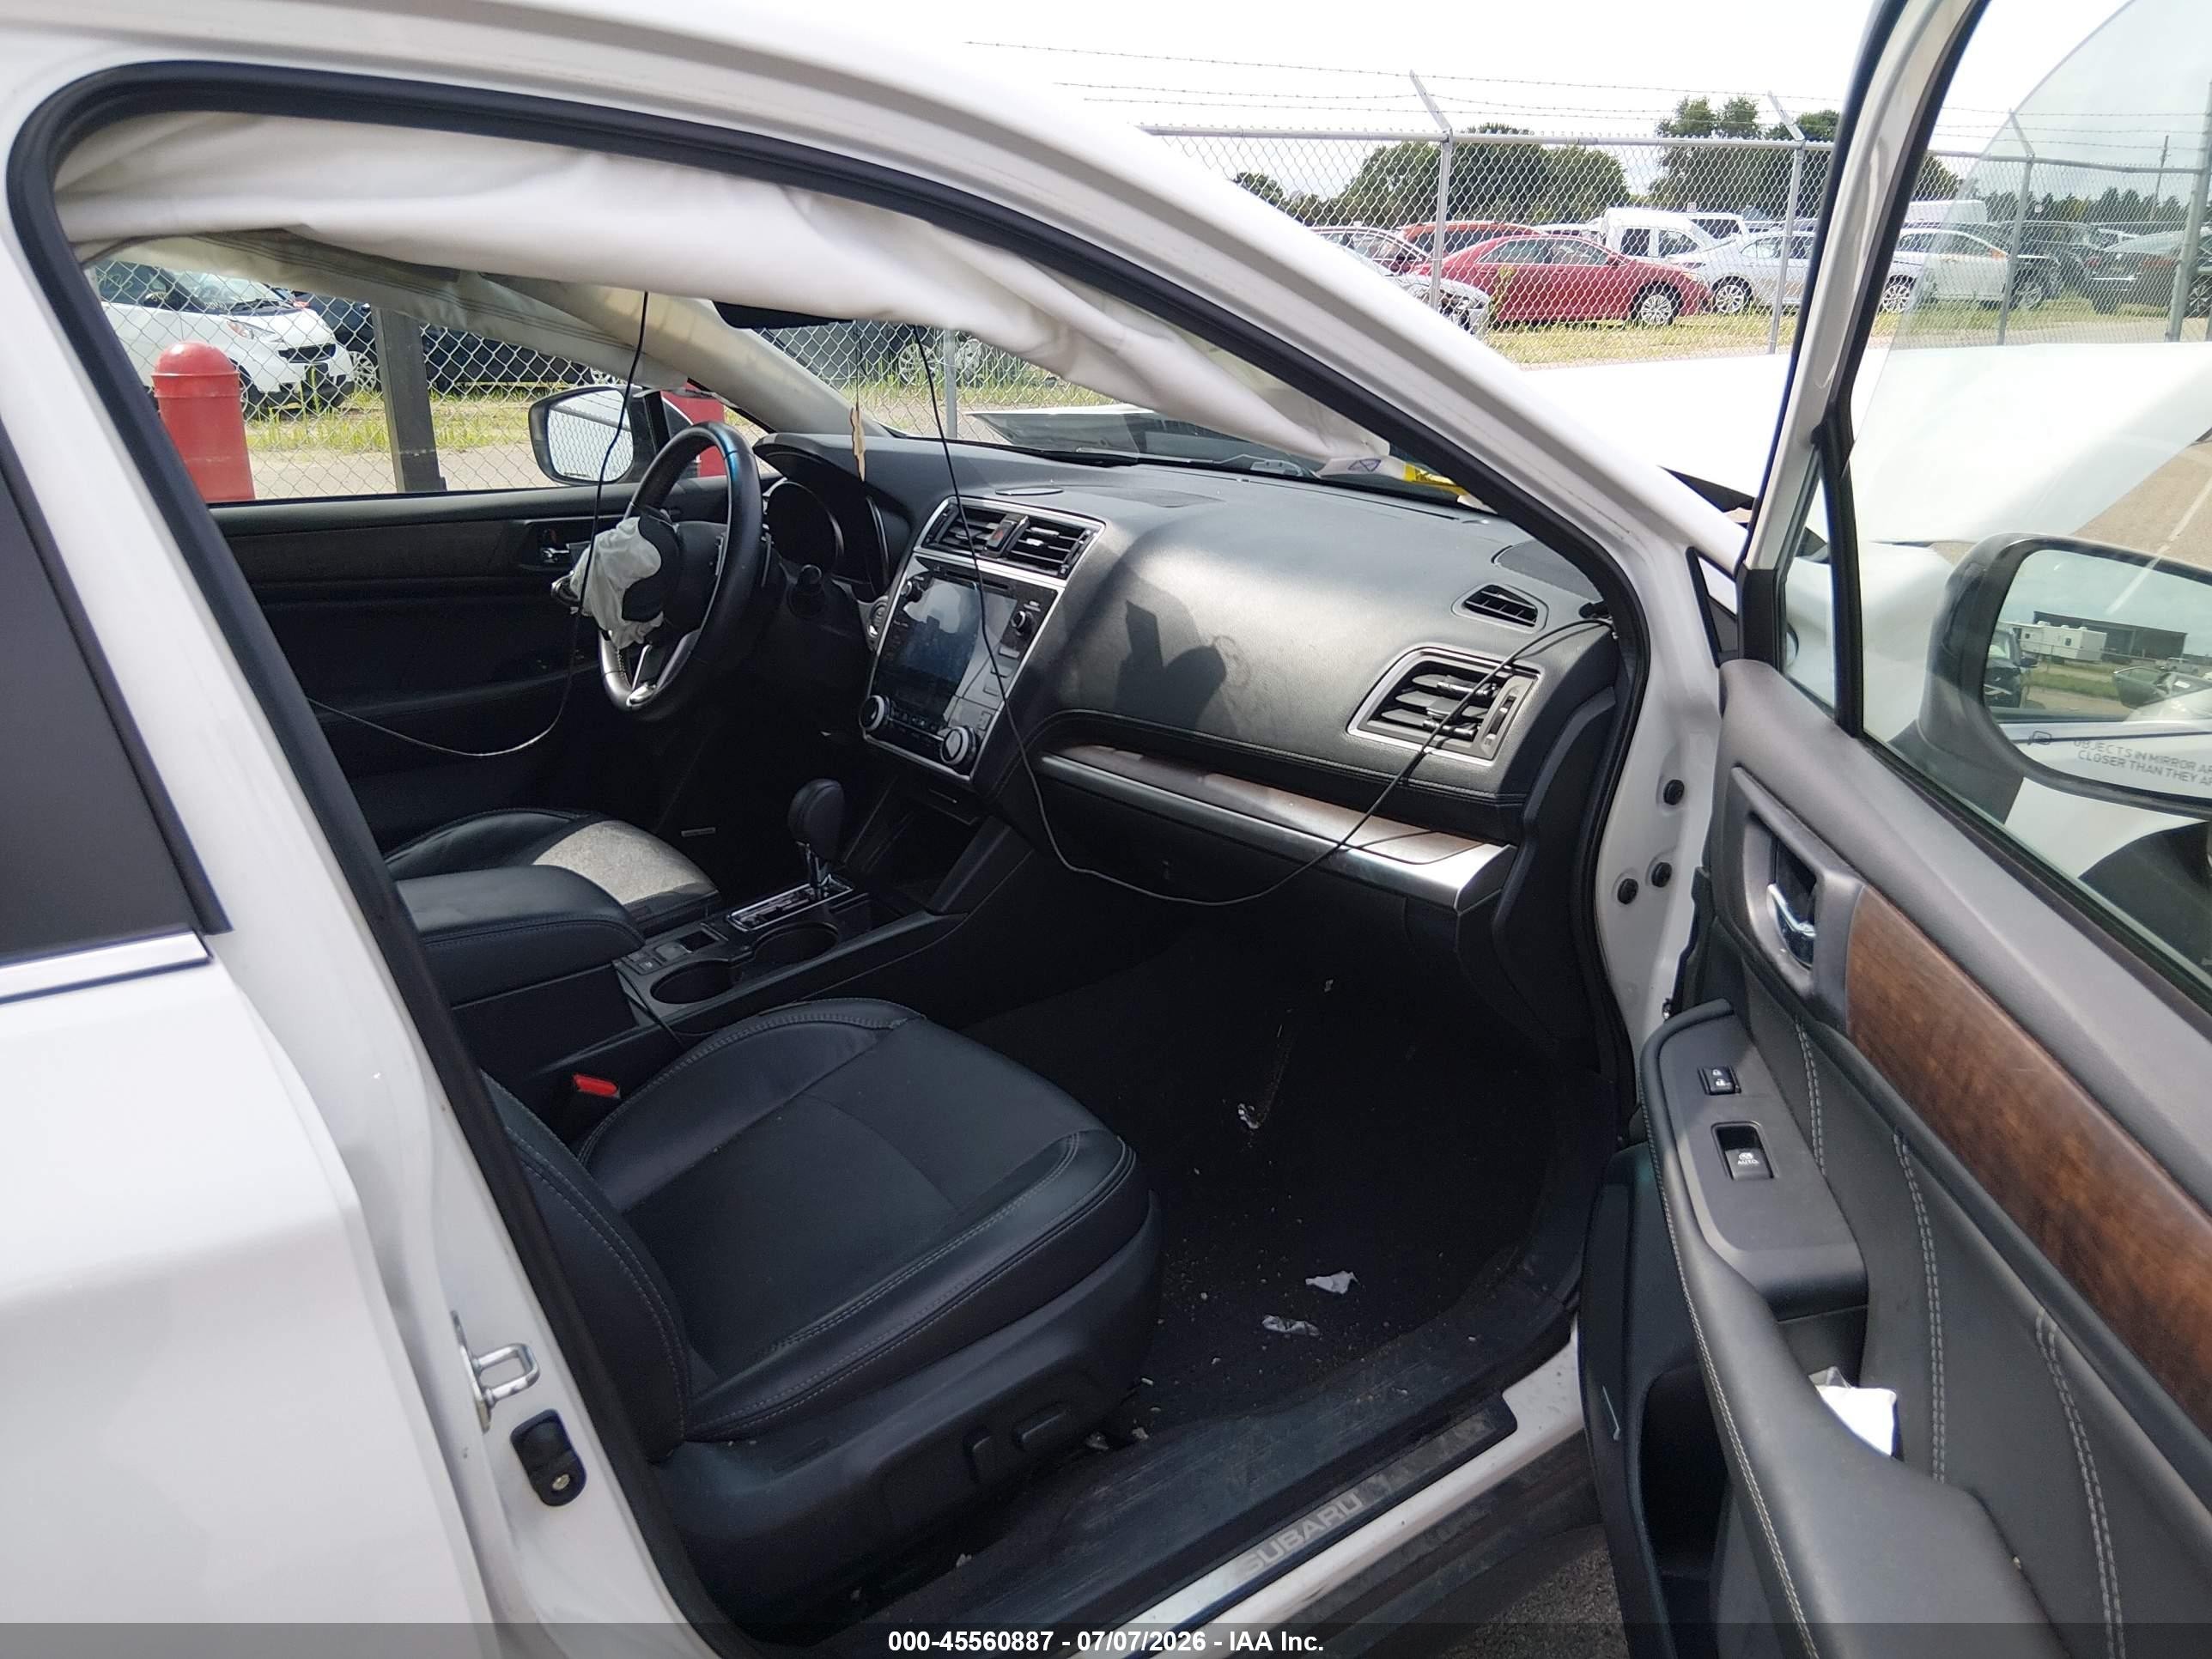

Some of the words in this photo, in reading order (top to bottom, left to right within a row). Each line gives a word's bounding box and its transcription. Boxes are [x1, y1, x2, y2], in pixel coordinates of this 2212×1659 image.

[2073, 740, 2133, 757] OBJECTS
[2135, 750, 2146, 761] IN
[2148, 752, 2197, 771] MIRROR
[2078, 750, 2126, 767] CLOSER
[2130, 760, 2163, 776] THAN
[2165, 768, 2198, 783] THEY
[1237, 1489, 1364, 1577] SUBARU
